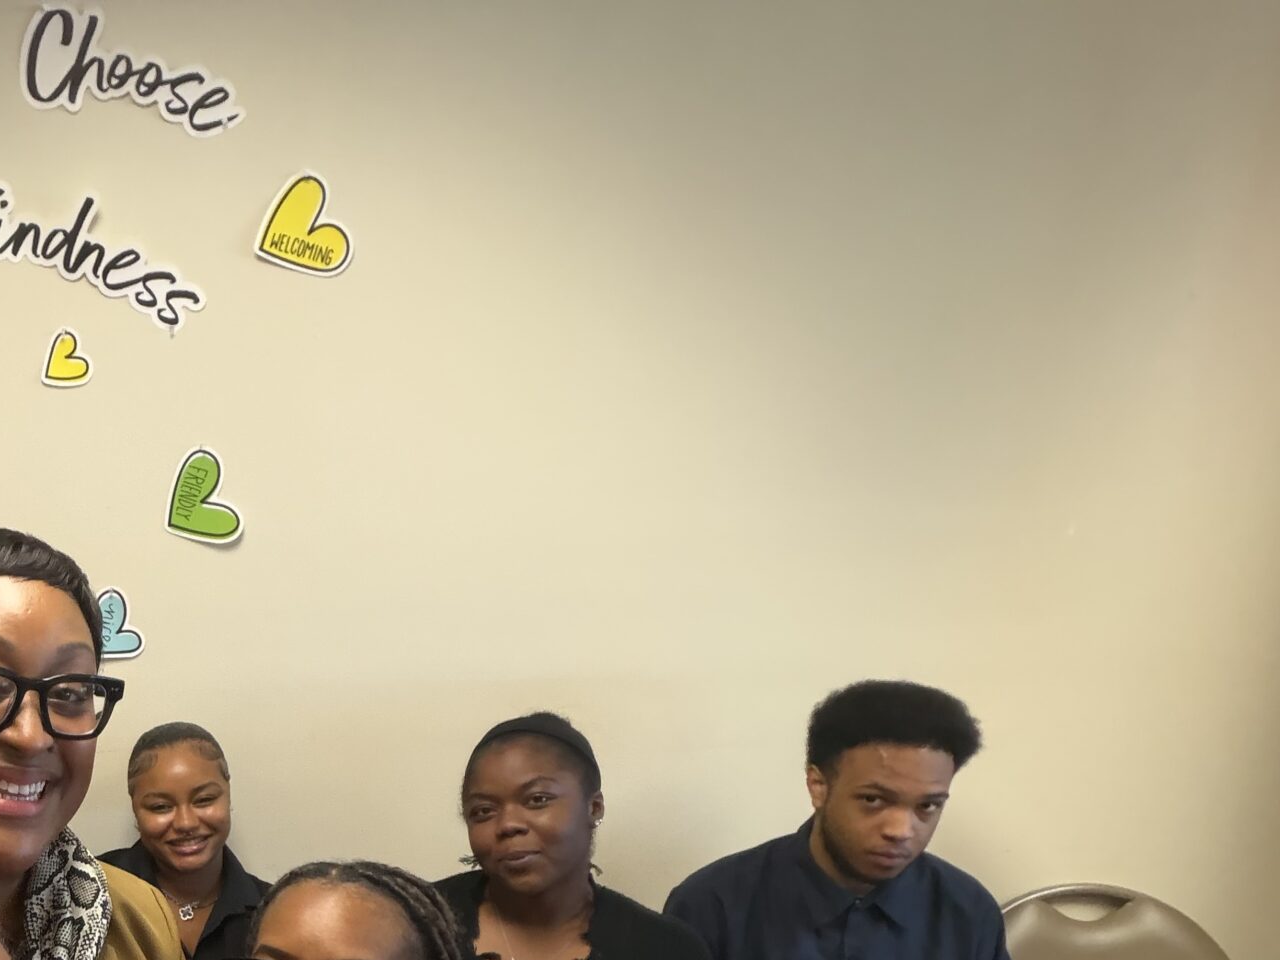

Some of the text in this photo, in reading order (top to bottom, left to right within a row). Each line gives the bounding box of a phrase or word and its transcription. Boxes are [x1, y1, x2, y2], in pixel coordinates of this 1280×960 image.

[25, 9, 239, 132] Choose
[269, 232, 334, 266] WELCOMING
[175, 465, 209, 522] FRIENDLY
